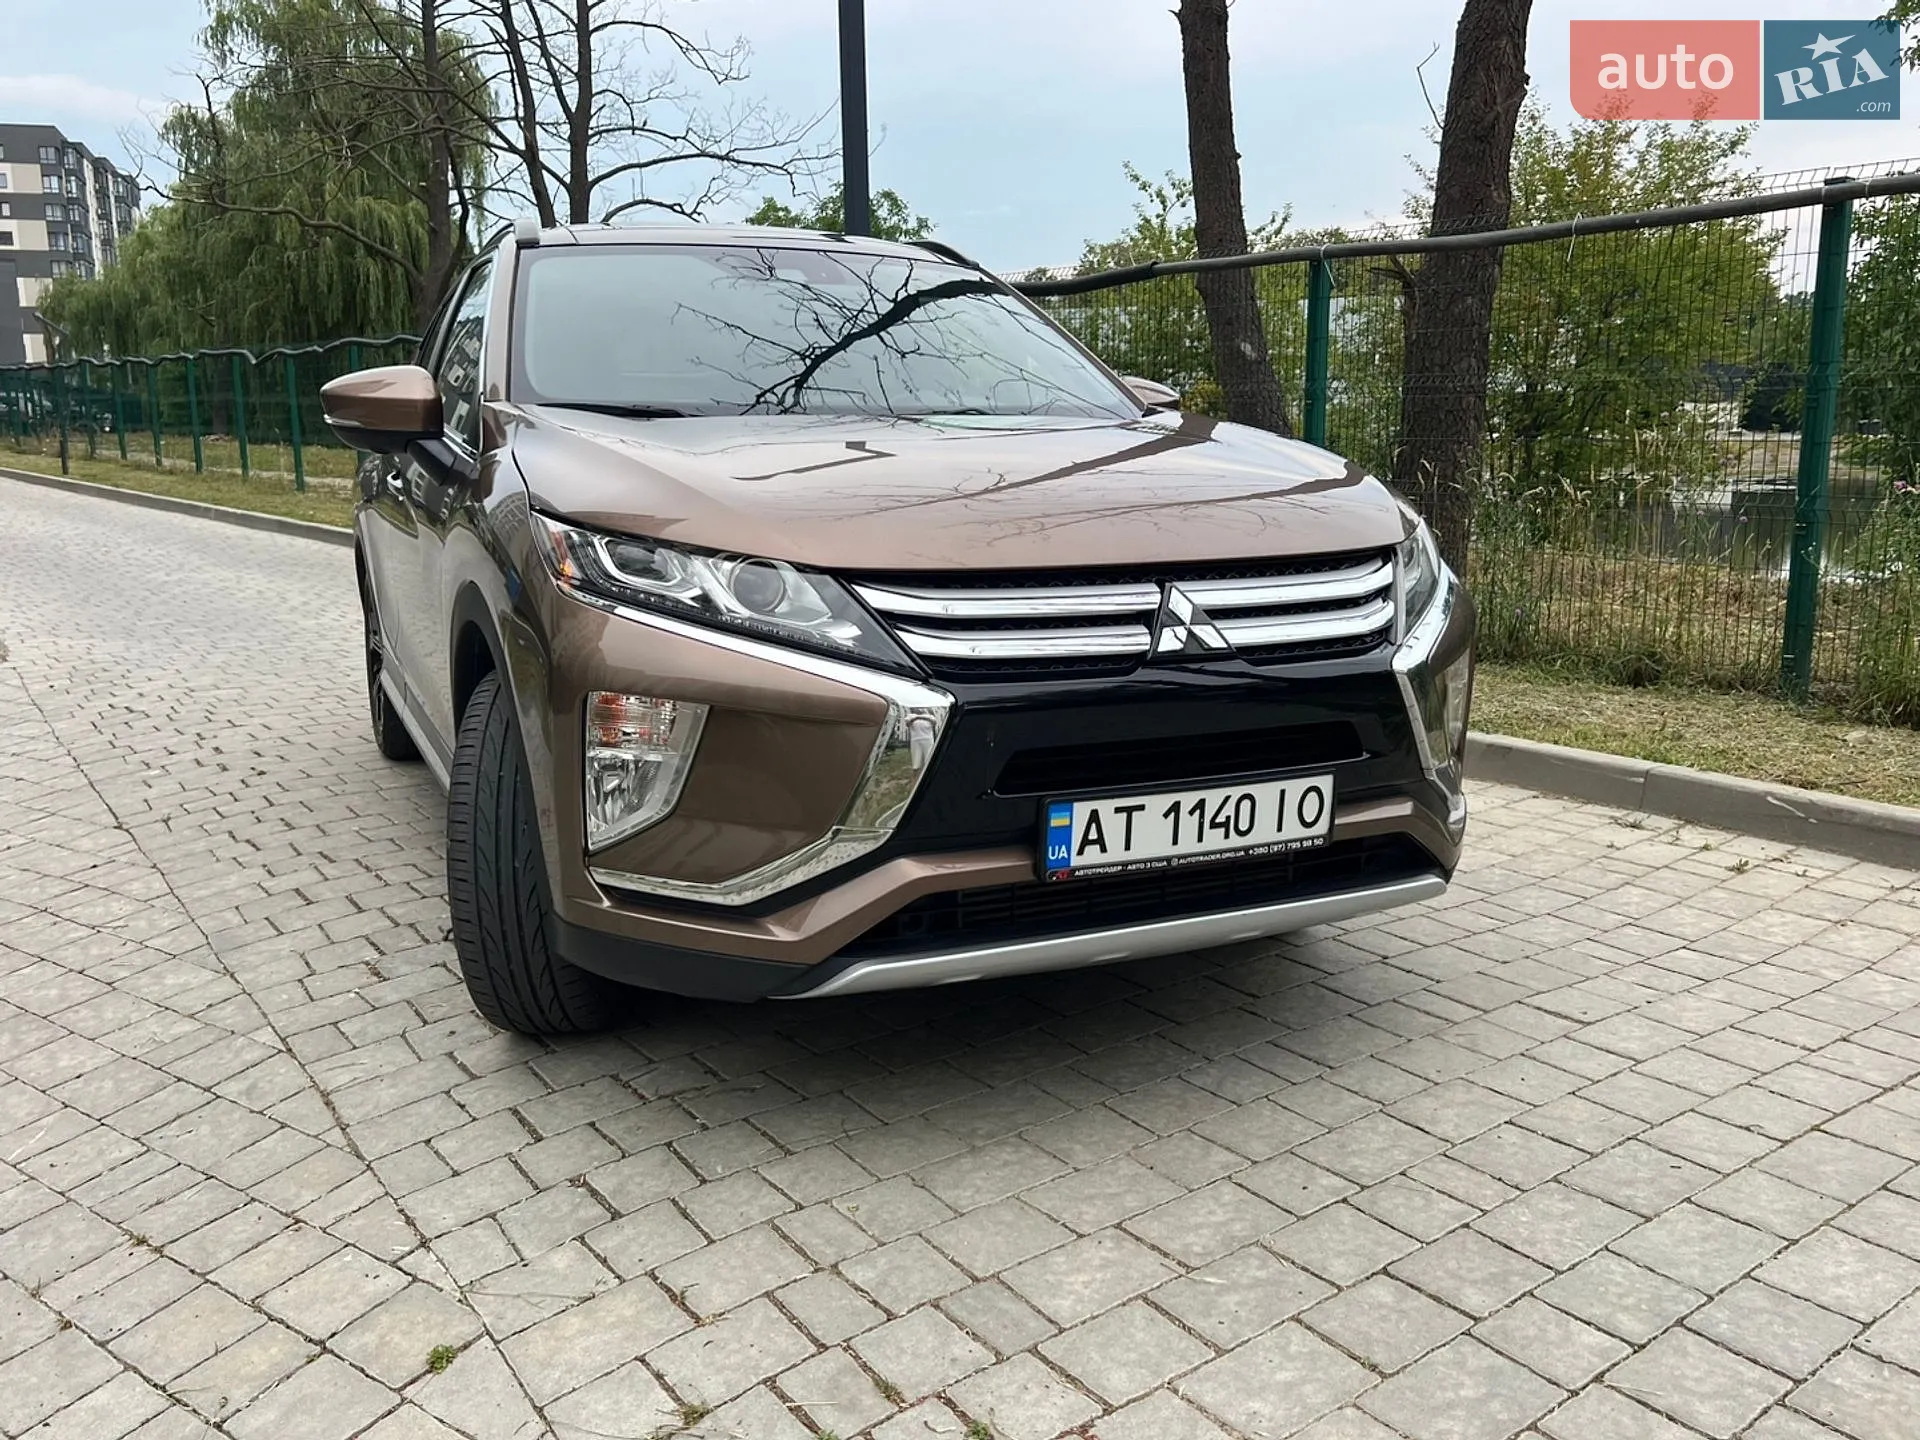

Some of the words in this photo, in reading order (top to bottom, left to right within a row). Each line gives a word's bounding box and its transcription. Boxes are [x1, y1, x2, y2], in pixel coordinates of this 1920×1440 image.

[1076, 803, 1146, 857] AT
[1162, 792, 1256, 846] 1140
[1276, 785, 1325, 833] IO
[1048, 842, 1069, 860] UA
